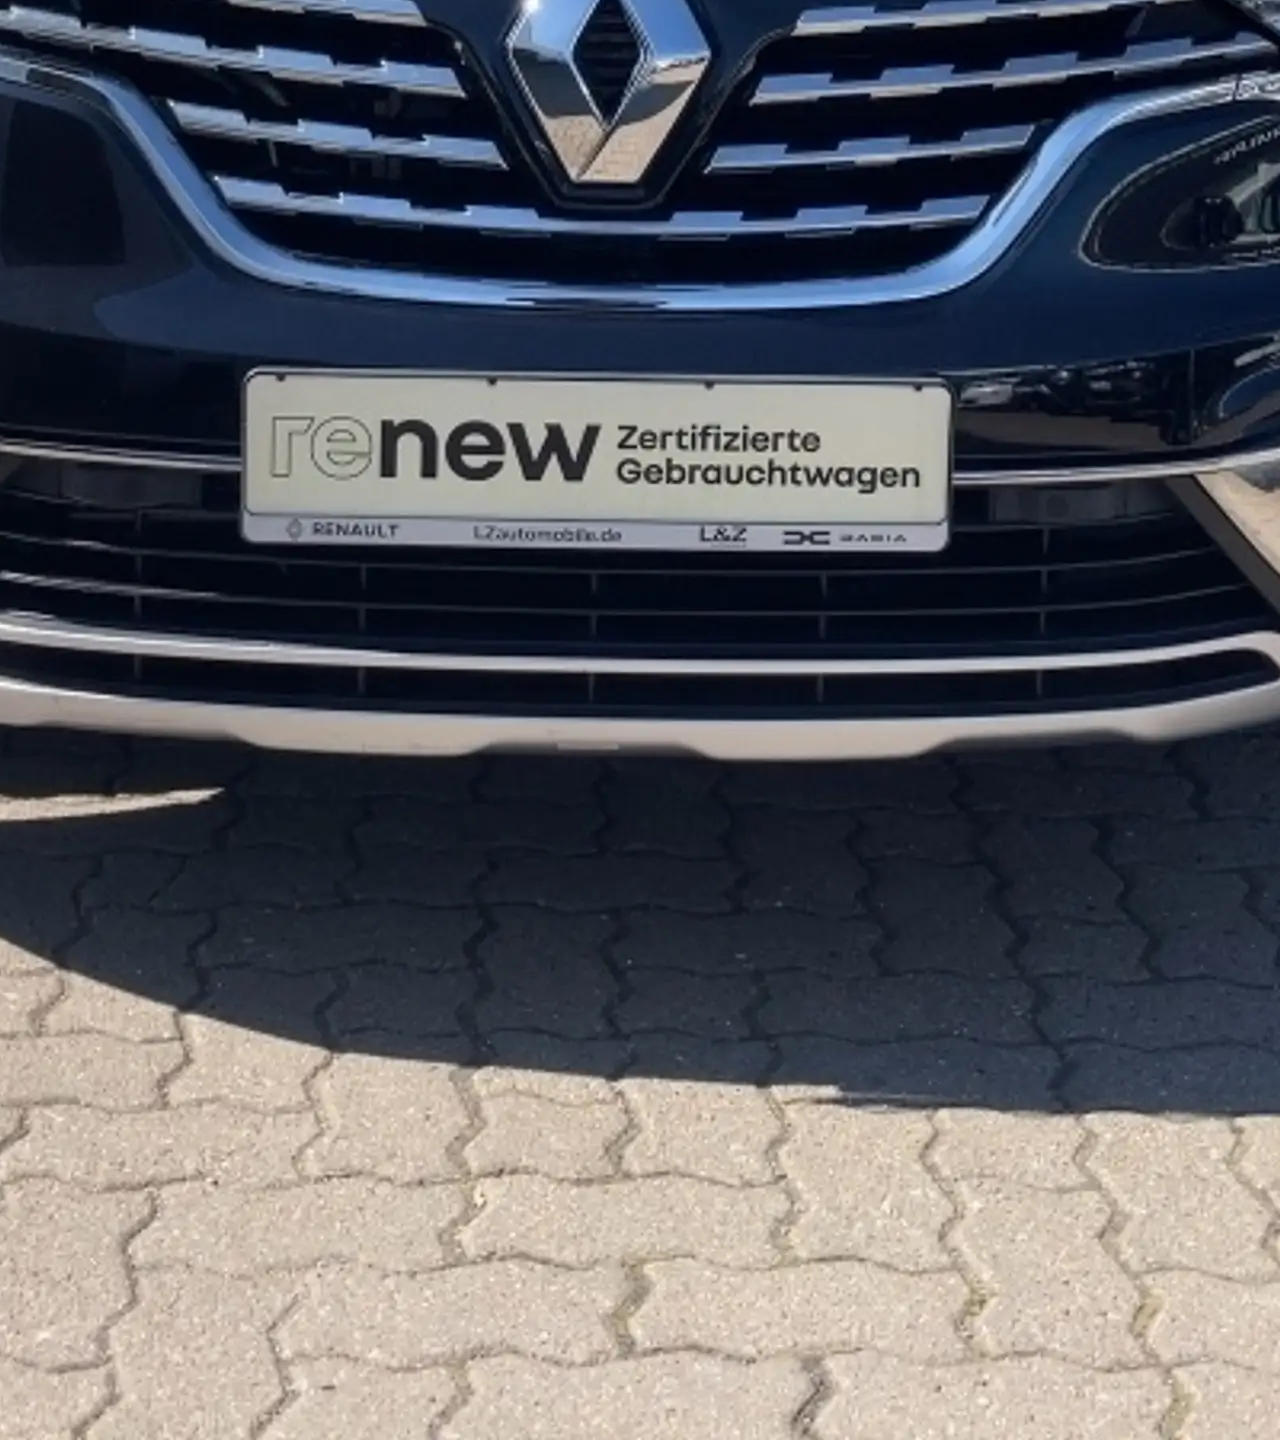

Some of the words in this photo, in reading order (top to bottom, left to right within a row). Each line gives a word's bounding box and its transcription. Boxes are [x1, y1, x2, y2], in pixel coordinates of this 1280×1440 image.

[270, 415, 601, 482] renew
[617, 424, 822, 453] Zertifizierte
[616, 458, 922, 495] Gebrauchtwagen
[312, 521, 400, 538] RENAULT
[699, 526, 748, 543] L&Z
